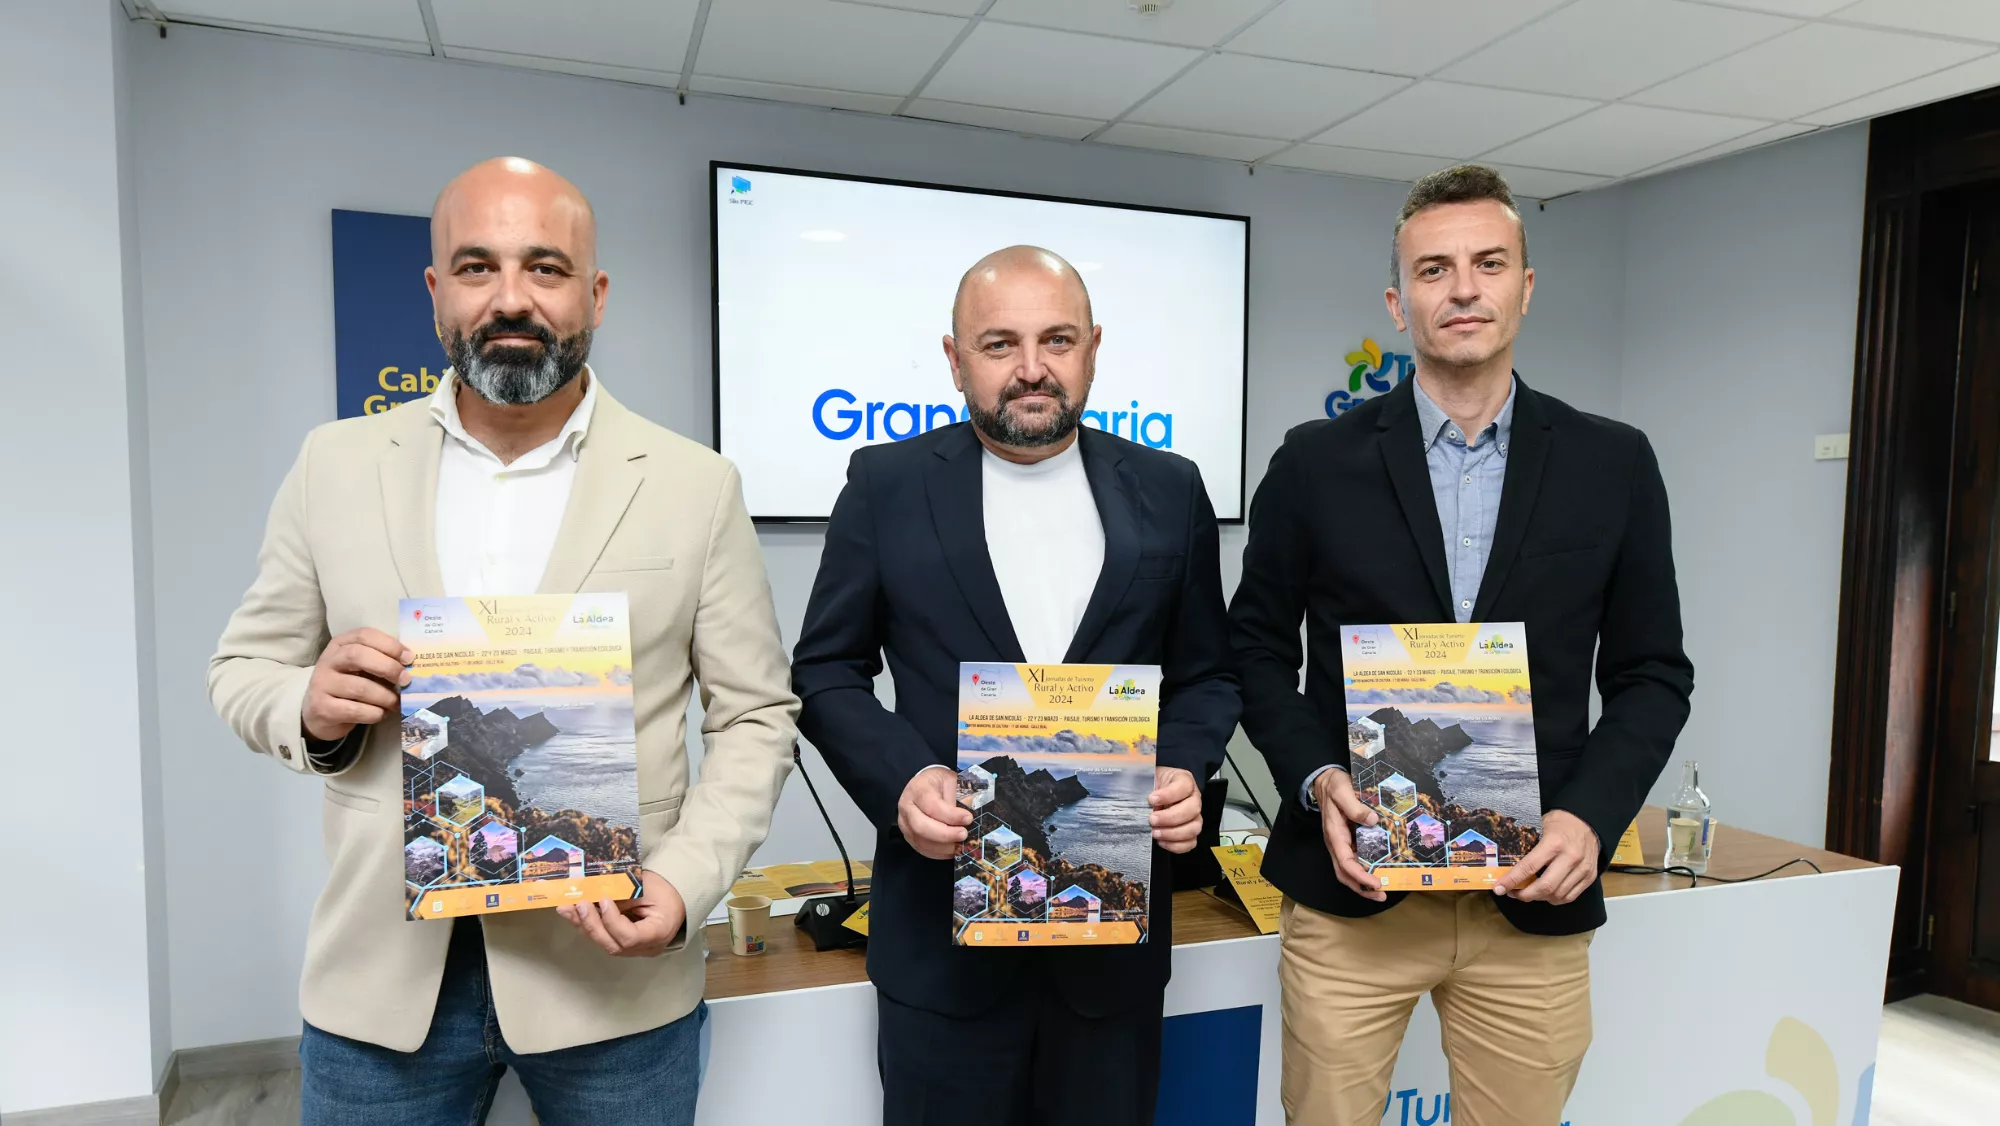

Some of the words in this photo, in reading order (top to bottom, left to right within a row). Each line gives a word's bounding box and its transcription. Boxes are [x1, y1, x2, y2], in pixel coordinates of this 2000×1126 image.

[479, 599, 497, 616] XI
[487, 615, 513, 624] Rural
[525, 614, 556, 622] Activo
[586, 614, 614, 623] Aldea
[504, 626, 532, 636] 2024
[1403, 628, 1418, 640] XI
[1479, 640, 1488, 649] La
[1425, 650, 1446, 658] 2024
[1028, 668, 1044, 682] XI
[1034, 683, 1057, 692] Rural
[1060, 686, 1064, 694] y
[1067, 684, 1094, 692] Activo
[1109, 686, 1119, 694] La
[1121, 686, 1146, 694] Aldea
[1049, 695, 1073, 704] 2024
[1229, 868, 1246, 877] XI
